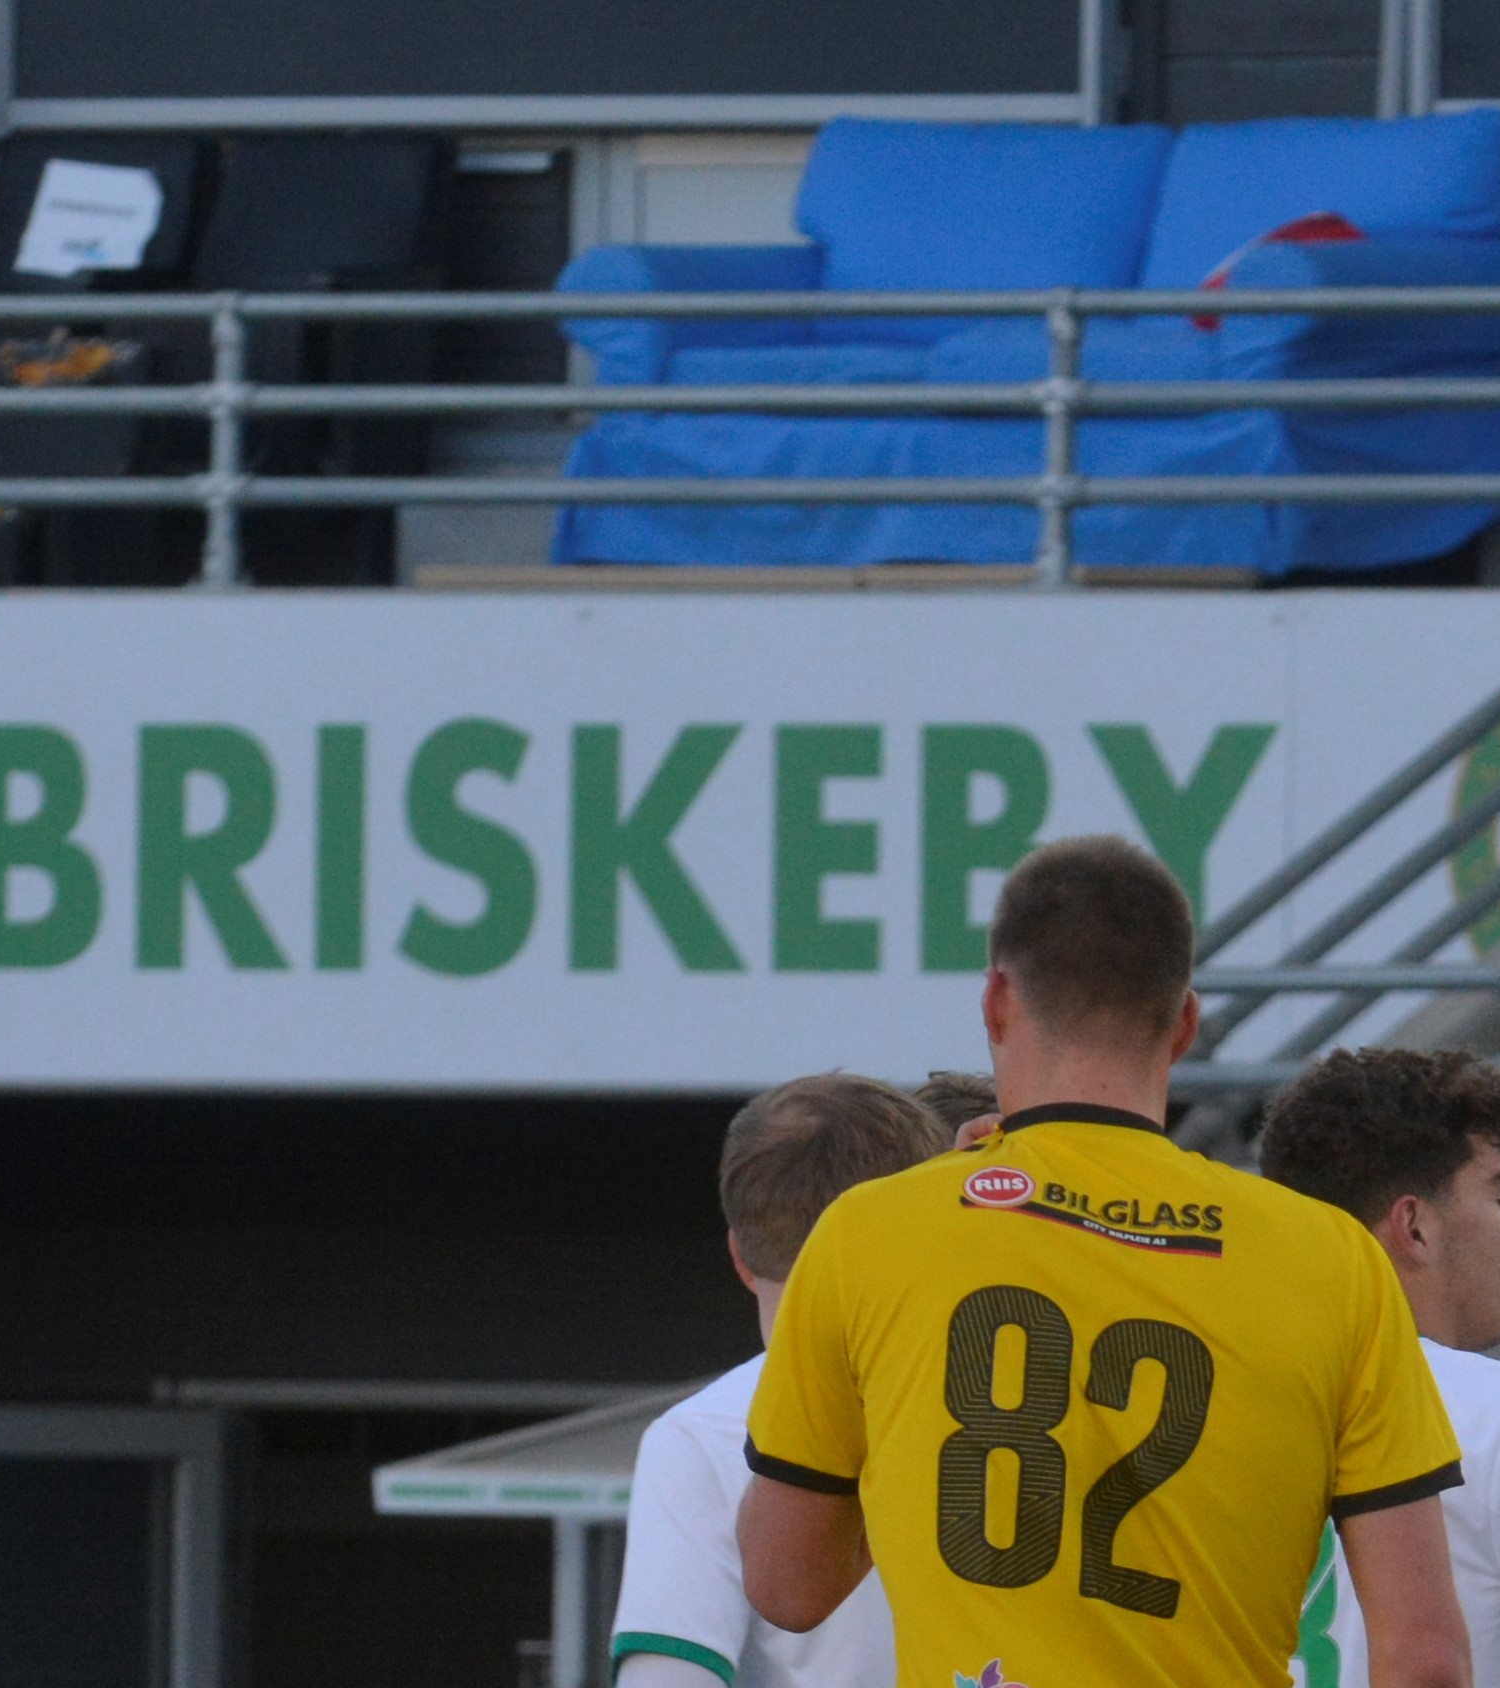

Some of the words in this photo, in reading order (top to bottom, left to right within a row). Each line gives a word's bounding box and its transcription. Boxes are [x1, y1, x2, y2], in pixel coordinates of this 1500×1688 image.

[973, 1176, 1025, 1192] RIIS
[1044, 1181, 1223, 1233] BILGLASS
[936, 1284, 1215, 1620] 82
